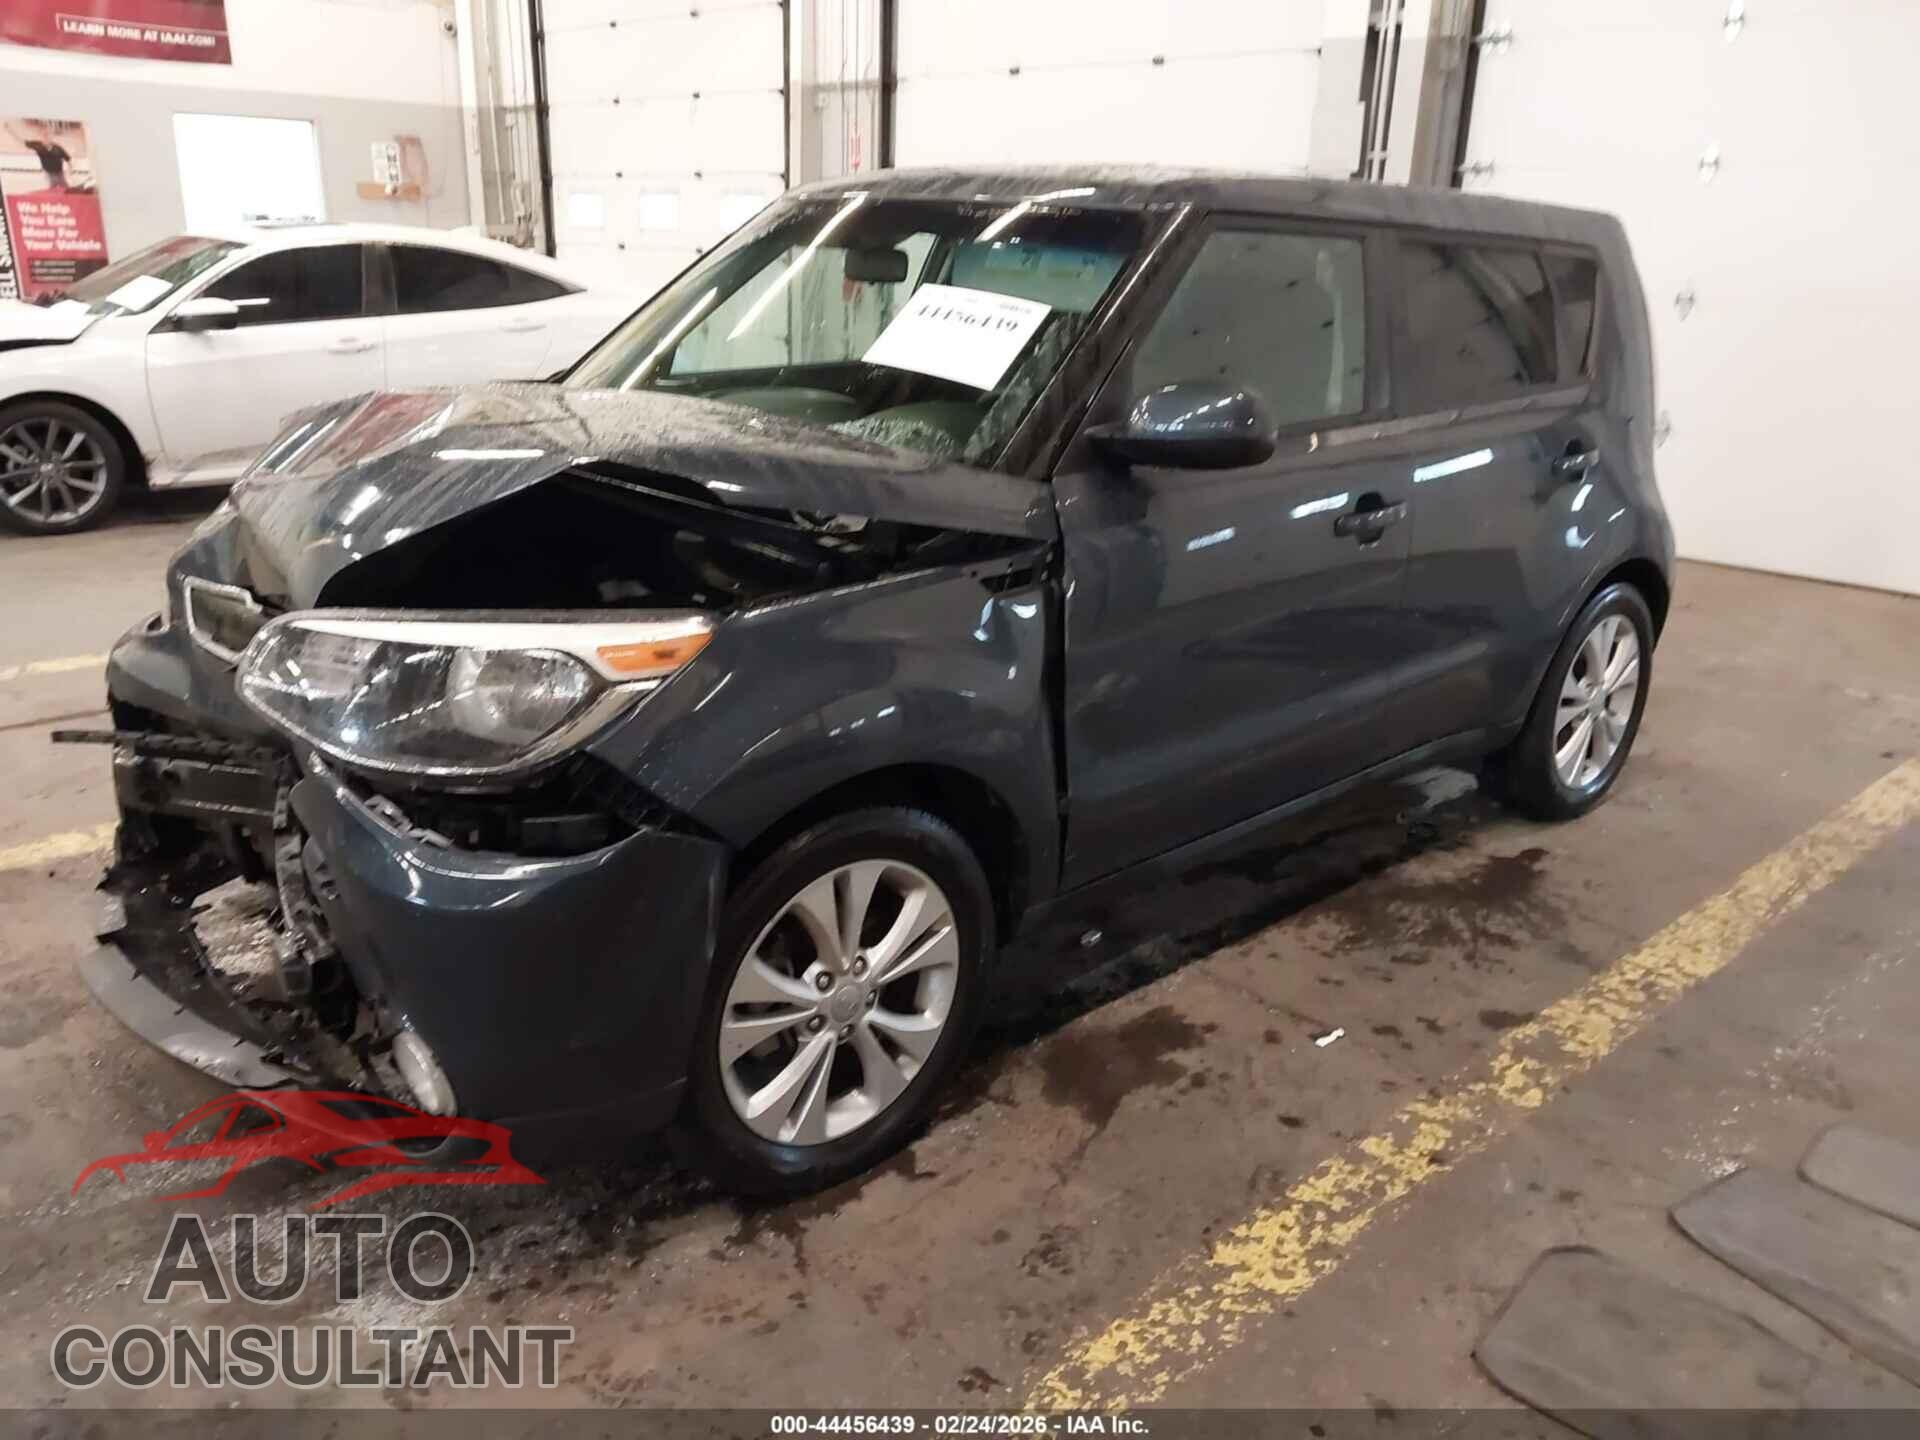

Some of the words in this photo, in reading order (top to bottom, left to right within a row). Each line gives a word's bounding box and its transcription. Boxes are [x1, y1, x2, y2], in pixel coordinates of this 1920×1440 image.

[63, 20, 105, 37] LEARN
[107, 26, 142, 41] MORE
[143, 30, 158, 42] AT
[16, 201, 38, 214] We
[40, 202, 71, 216] Help
[20, 214, 45, 226] You
[47, 215, 77, 227] Earn
[22, 226, 55, 238] More
[57, 227, 79, 239] For
[24, 239, 54, 251] Your
[55, 239, 102, 251] Vehicle
